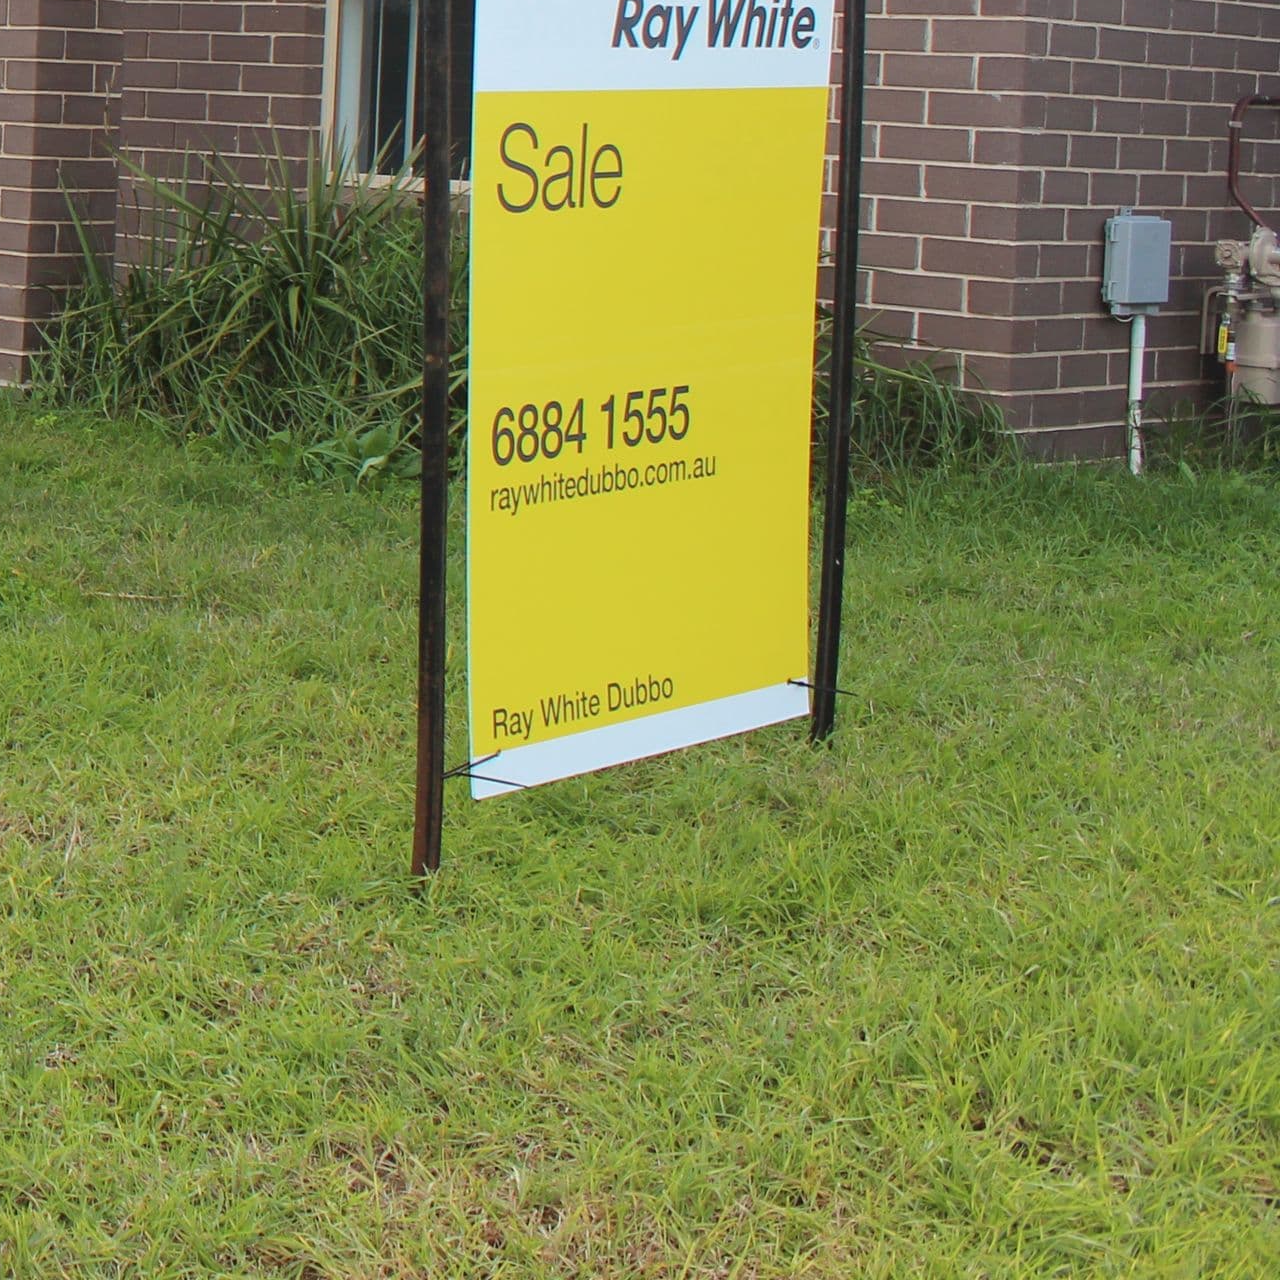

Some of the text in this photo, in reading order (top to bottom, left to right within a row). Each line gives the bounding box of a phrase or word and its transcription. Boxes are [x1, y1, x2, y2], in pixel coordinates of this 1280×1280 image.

[496, 122, 623, 213] Sale
[491, 385, 690, 466] 6884 1555
[490, 455, 716, 516] raywhitedubbo.com.au
[492, 674, 674, 740] Ray White Dubbo
